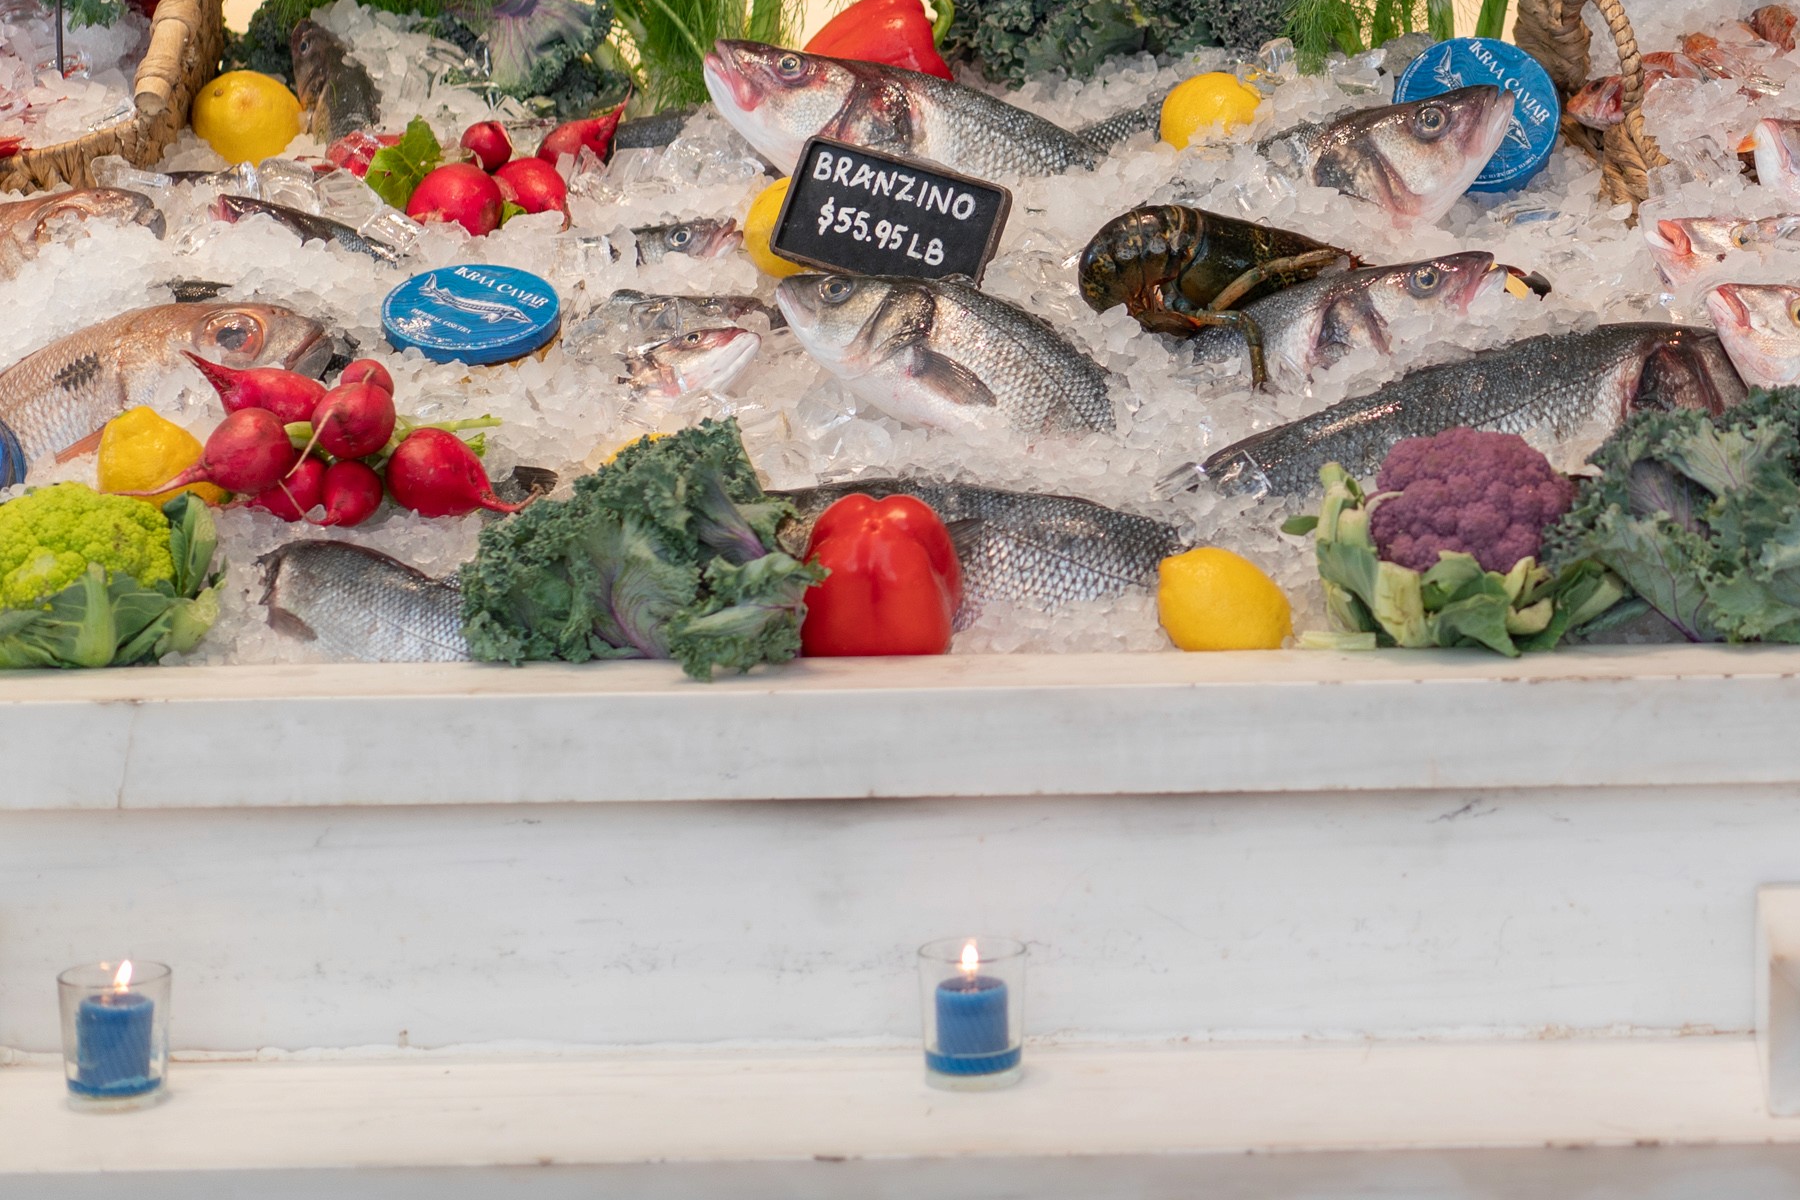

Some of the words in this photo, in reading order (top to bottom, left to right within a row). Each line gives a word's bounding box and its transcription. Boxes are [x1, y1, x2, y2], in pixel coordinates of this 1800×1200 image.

[1468, 40, 1505, 80] IKRAA
[1504, 77, 1551, 123] CAVIAR
[813, 151, 976, 220] BRANZINO
[818, 196, 909, 250] $55.95
[906, 233, 945, 266] LB
[454, 266, 495, 288] IKRAA
[496, 283, 549, 307] CAVIAR
